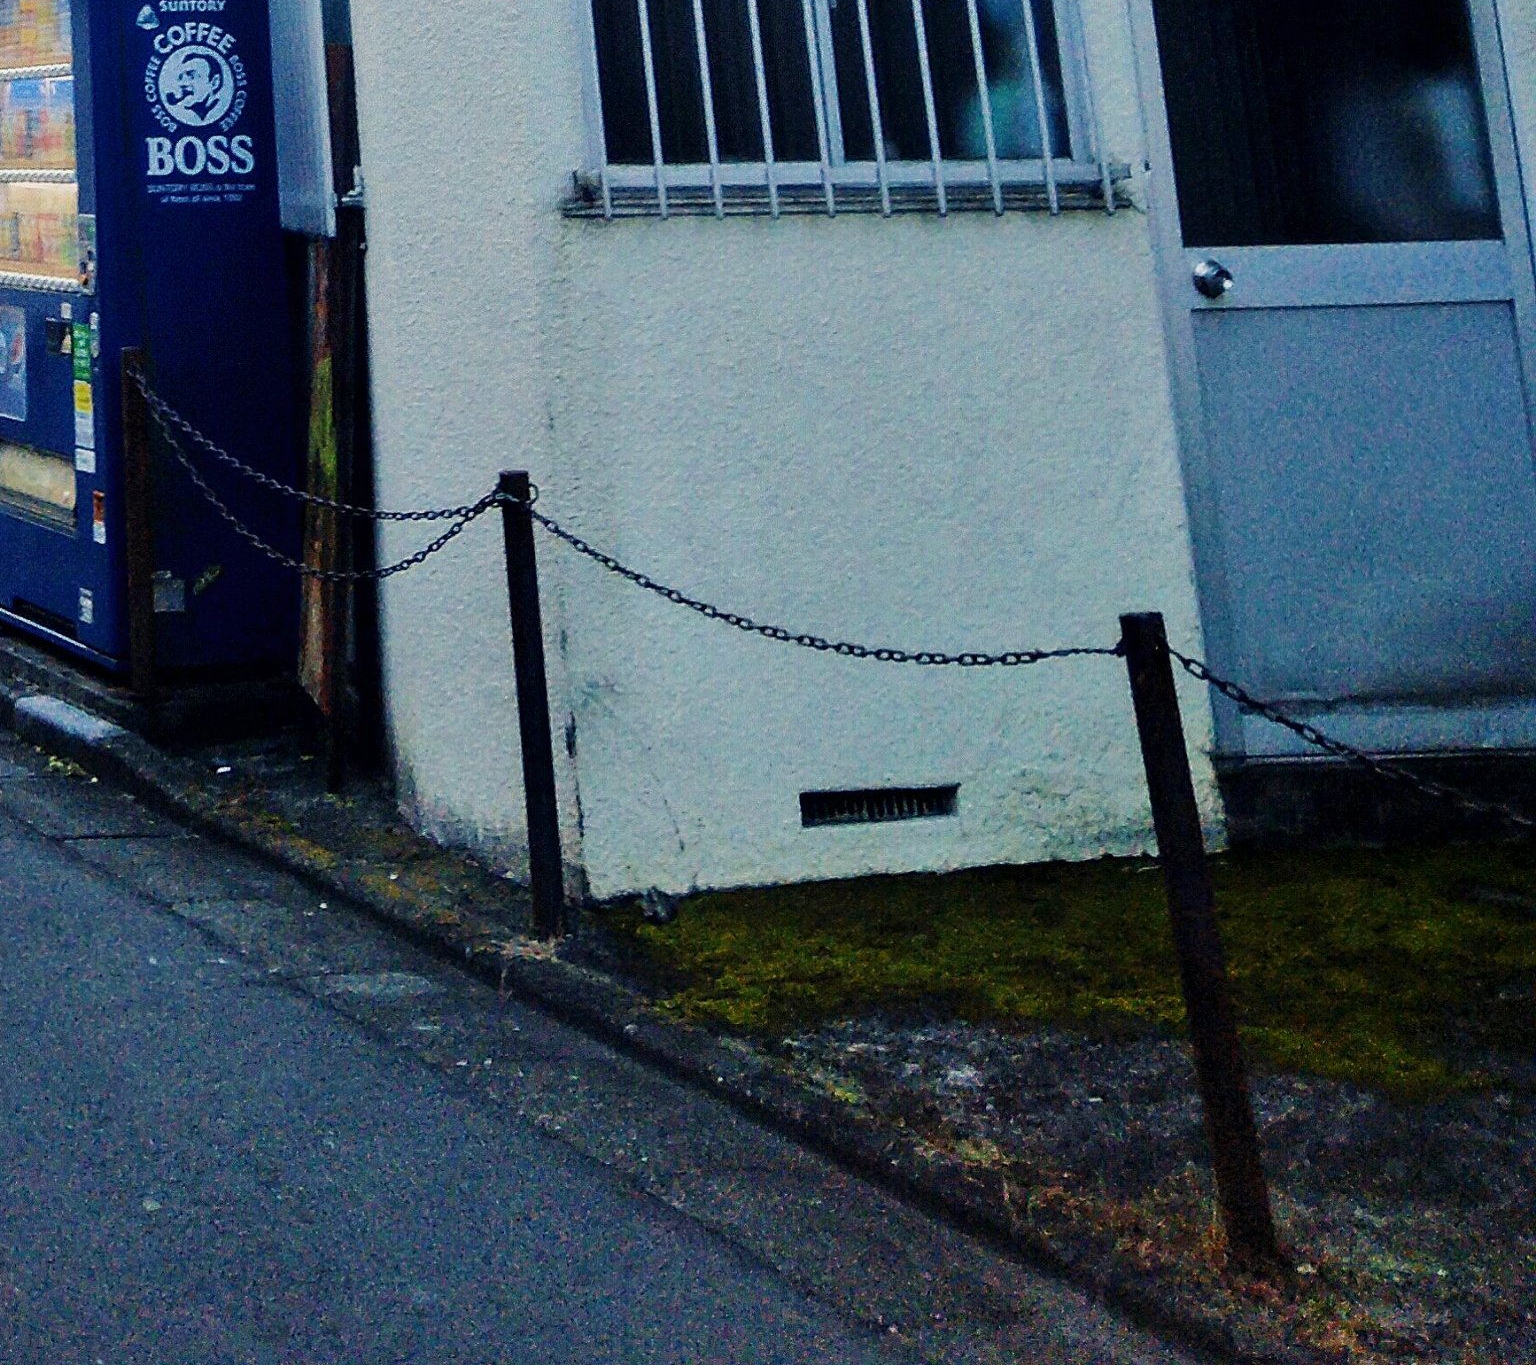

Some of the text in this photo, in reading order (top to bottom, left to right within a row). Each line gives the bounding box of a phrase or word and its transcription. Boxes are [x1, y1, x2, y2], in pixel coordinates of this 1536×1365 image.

[159, 0, 226, 12] SUNTORY
[153, 22, 237, 55] COFFEE
[145, 135, 255, 176] BOSS
